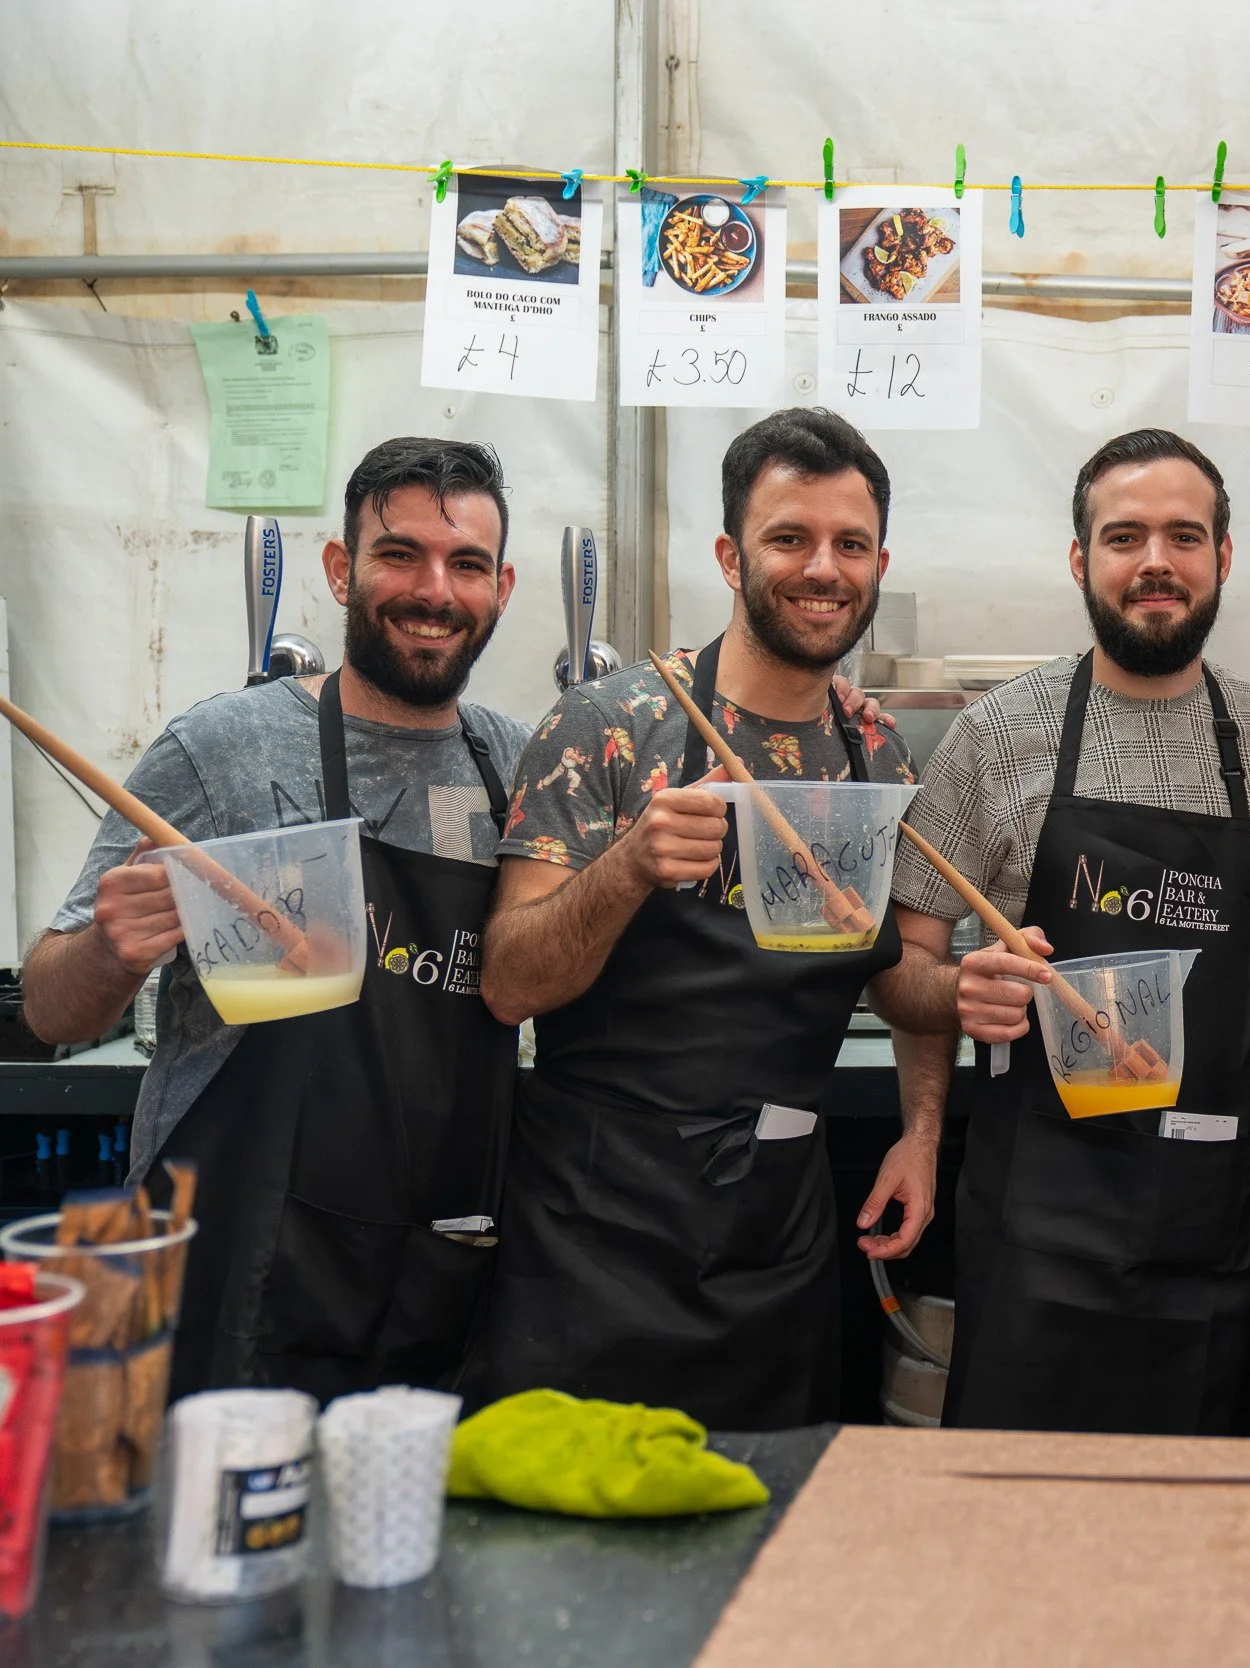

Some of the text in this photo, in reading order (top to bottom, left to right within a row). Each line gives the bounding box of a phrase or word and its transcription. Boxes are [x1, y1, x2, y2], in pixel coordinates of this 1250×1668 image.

[466, 290, 561, 305] BOLO DO CACO COM
[474, 301, 520, 312] MANTEIGA
[689, 314, 717, 322] CHIPS
[863, 313, 937, 321] FRANGO ASSADO
[262, 528, 275, 596] FOSTER'S
[583, 539, 593, 605] FOSTER'S
[1168, 870, 1223, 890] PONCHA
[1165, 886, 1206, 905] BAR &
[1162, 903, 1220, 923] EATERY
[1166, 919, 1178, 927] LA
[1178, 920, 1204, 931] MOTTE
[1204, 923, 1230, 932] STREET
